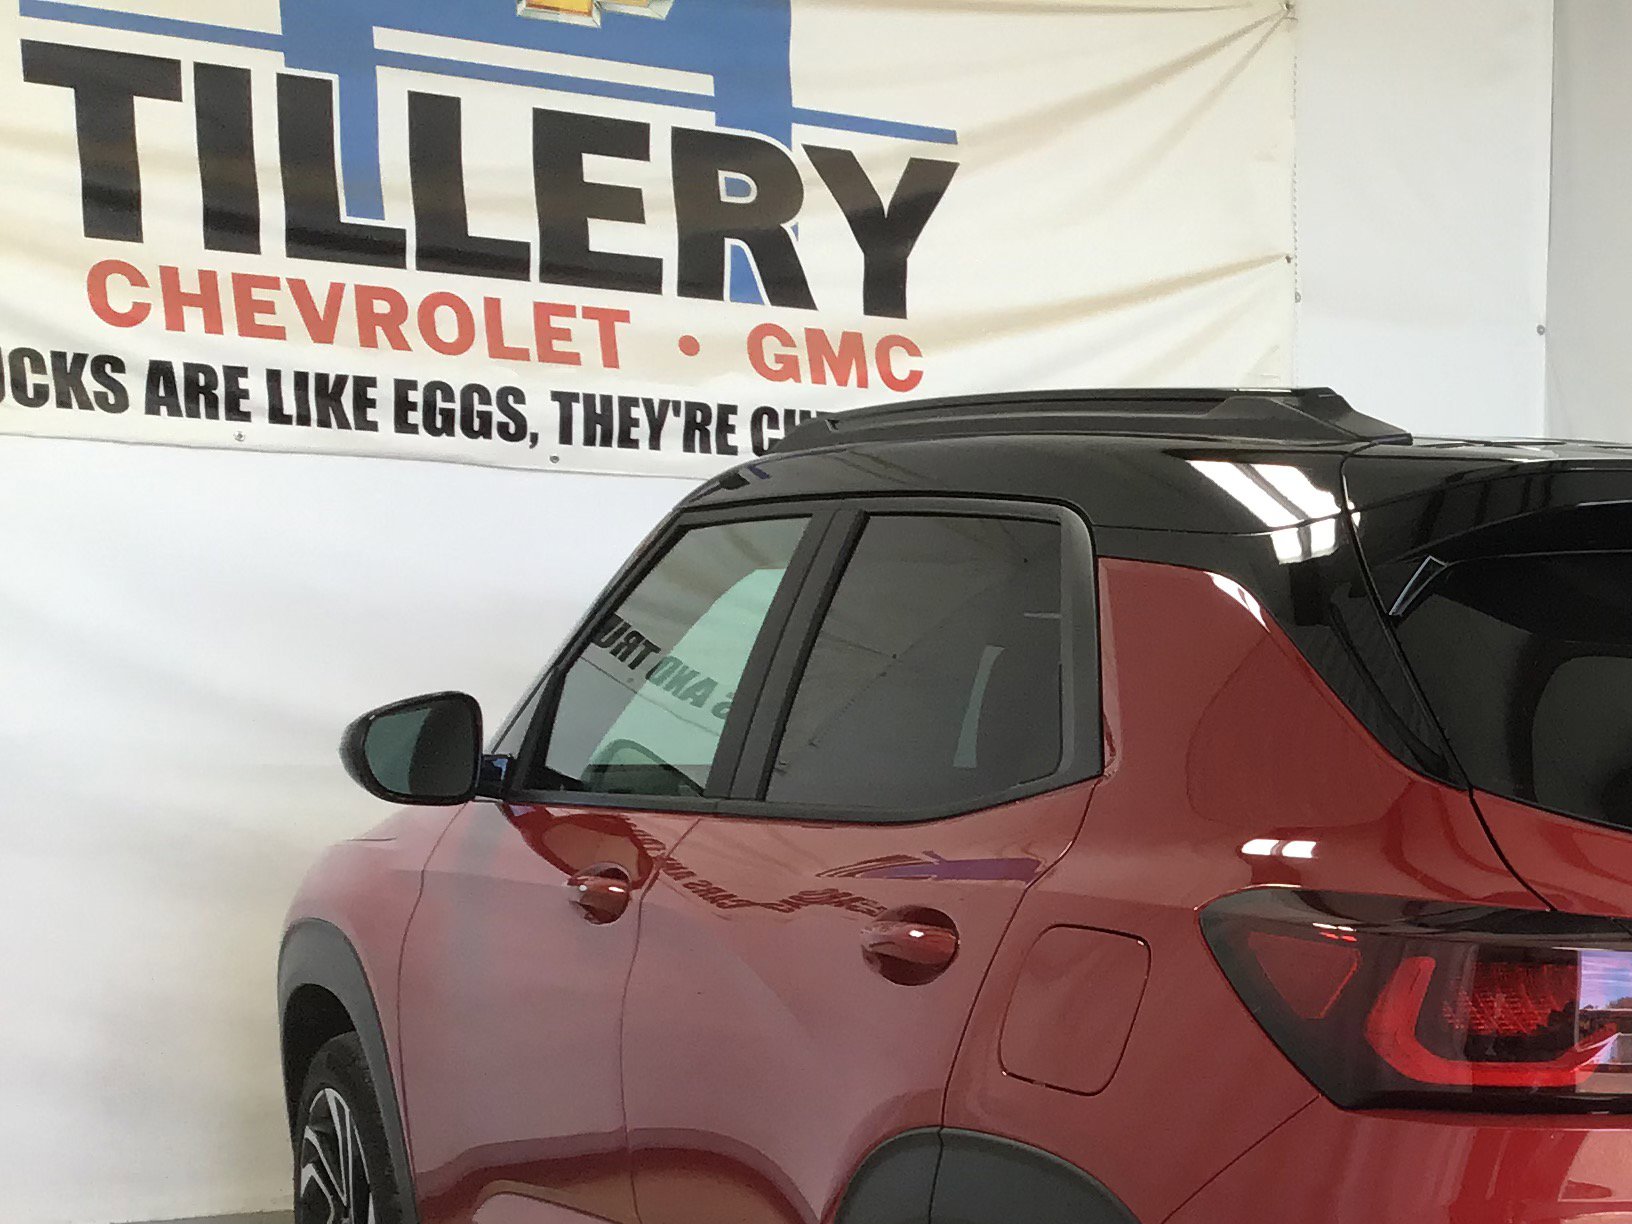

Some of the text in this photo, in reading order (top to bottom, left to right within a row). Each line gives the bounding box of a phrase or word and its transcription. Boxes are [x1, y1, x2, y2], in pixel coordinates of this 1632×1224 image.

[21, 40, 959, 319] TILLERY
[86, 259, 923, 392] CHEVROLET GMC
[0, 347, 130, 414] CKS
[145, 359, 251, 422] ARE
[266, 368, 378, 432] LIKE
[393, 378, 539, 448] EGGS,
[550, 390, 739, 456] THEY'RE
